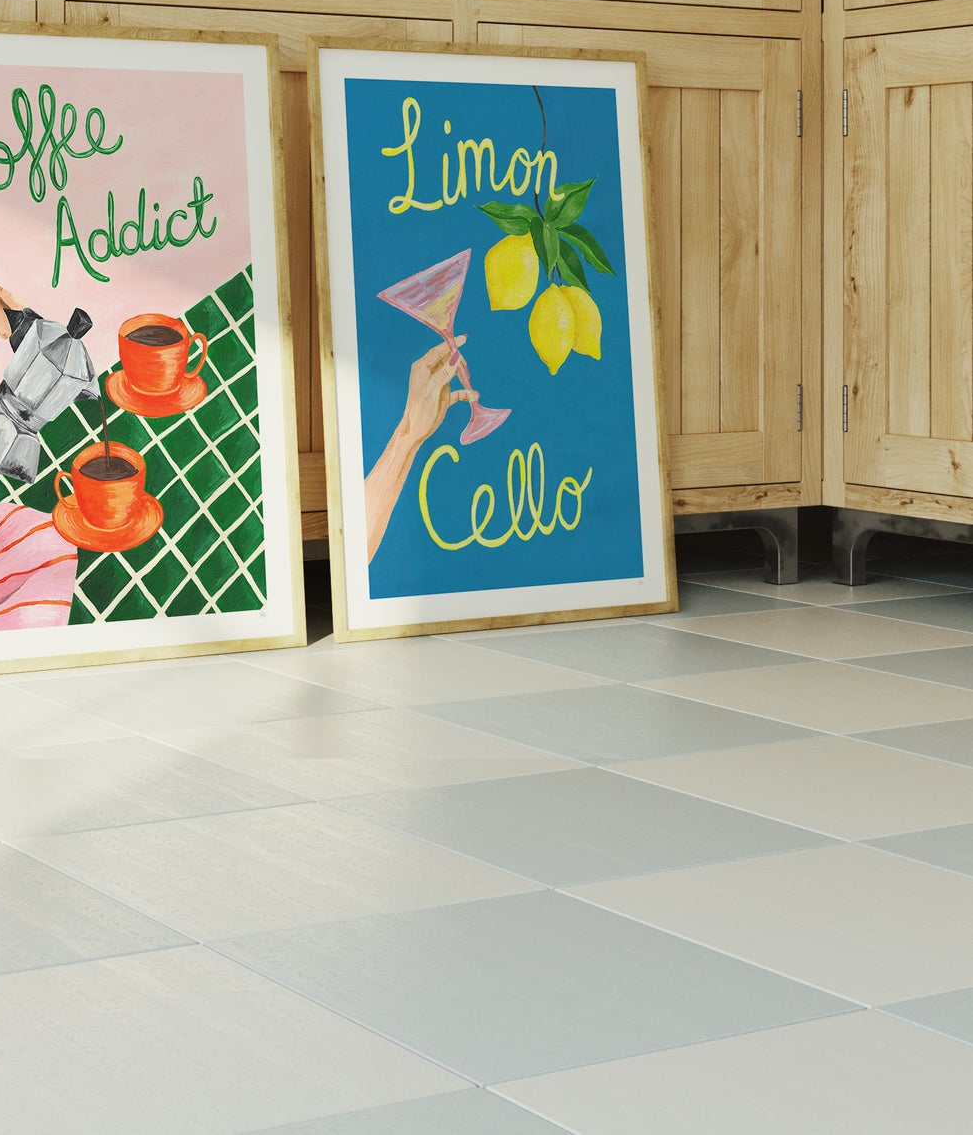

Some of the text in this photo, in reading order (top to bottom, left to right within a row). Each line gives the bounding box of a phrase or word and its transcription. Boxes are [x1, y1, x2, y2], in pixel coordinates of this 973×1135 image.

[380, 96, 565, 215] Limon
[51, 176, 218, 289] Addict
[418, 442, 593, 551] Cello
